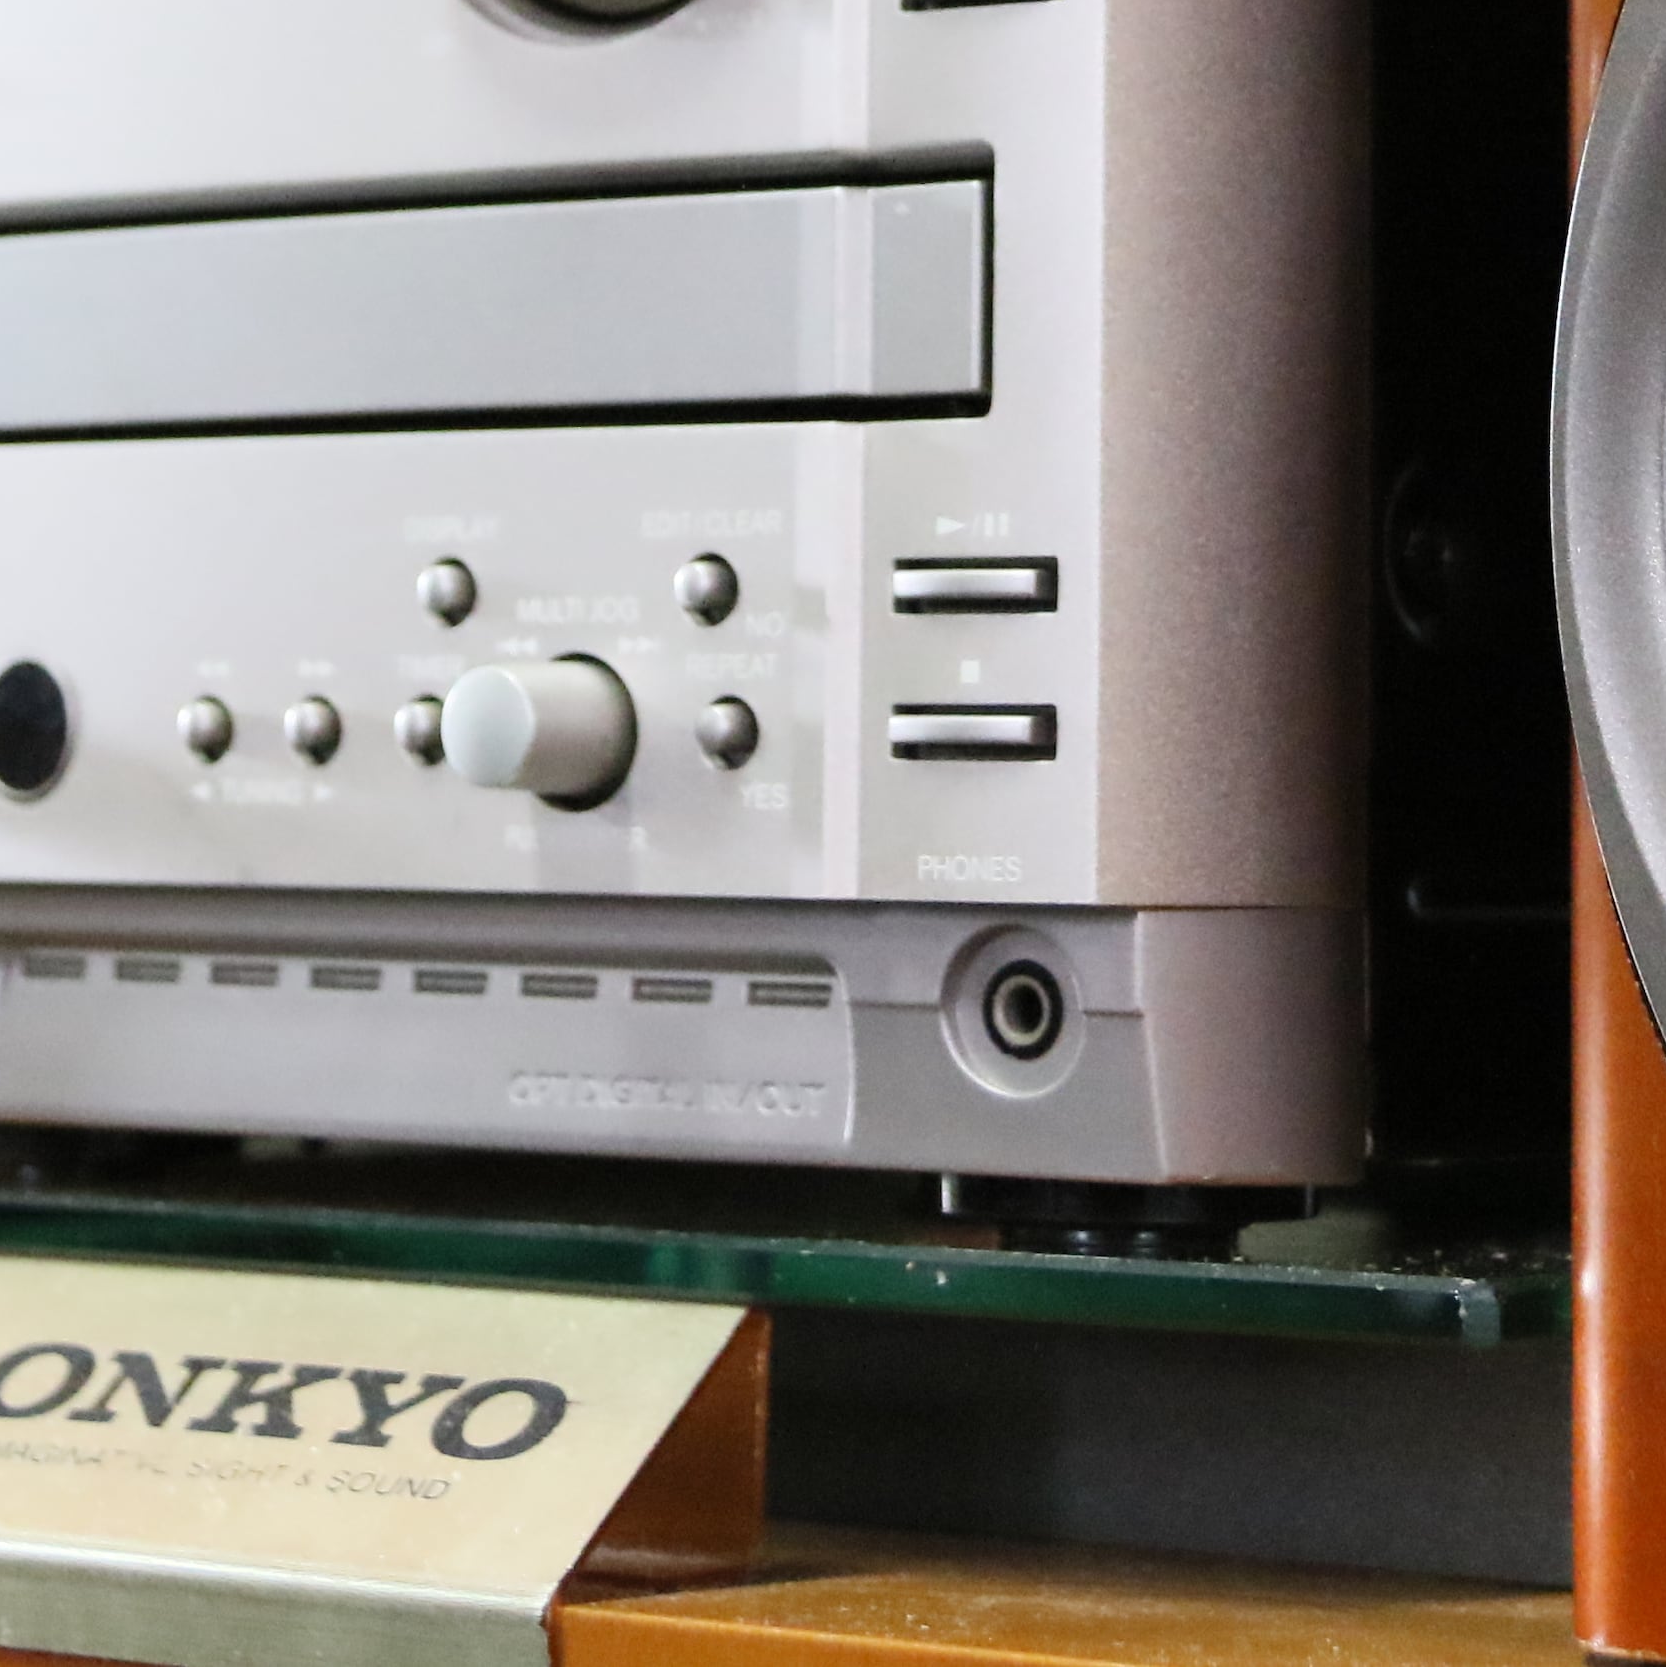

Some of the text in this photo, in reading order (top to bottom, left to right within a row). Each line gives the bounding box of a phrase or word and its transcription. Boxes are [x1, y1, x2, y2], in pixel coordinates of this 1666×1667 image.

[745, 611, 785, 638] NO
[739, 782, 788, 810] YES
[916, 853, 1023, 883] PHONES
[325, 1469, 451, 1501] SOUND
